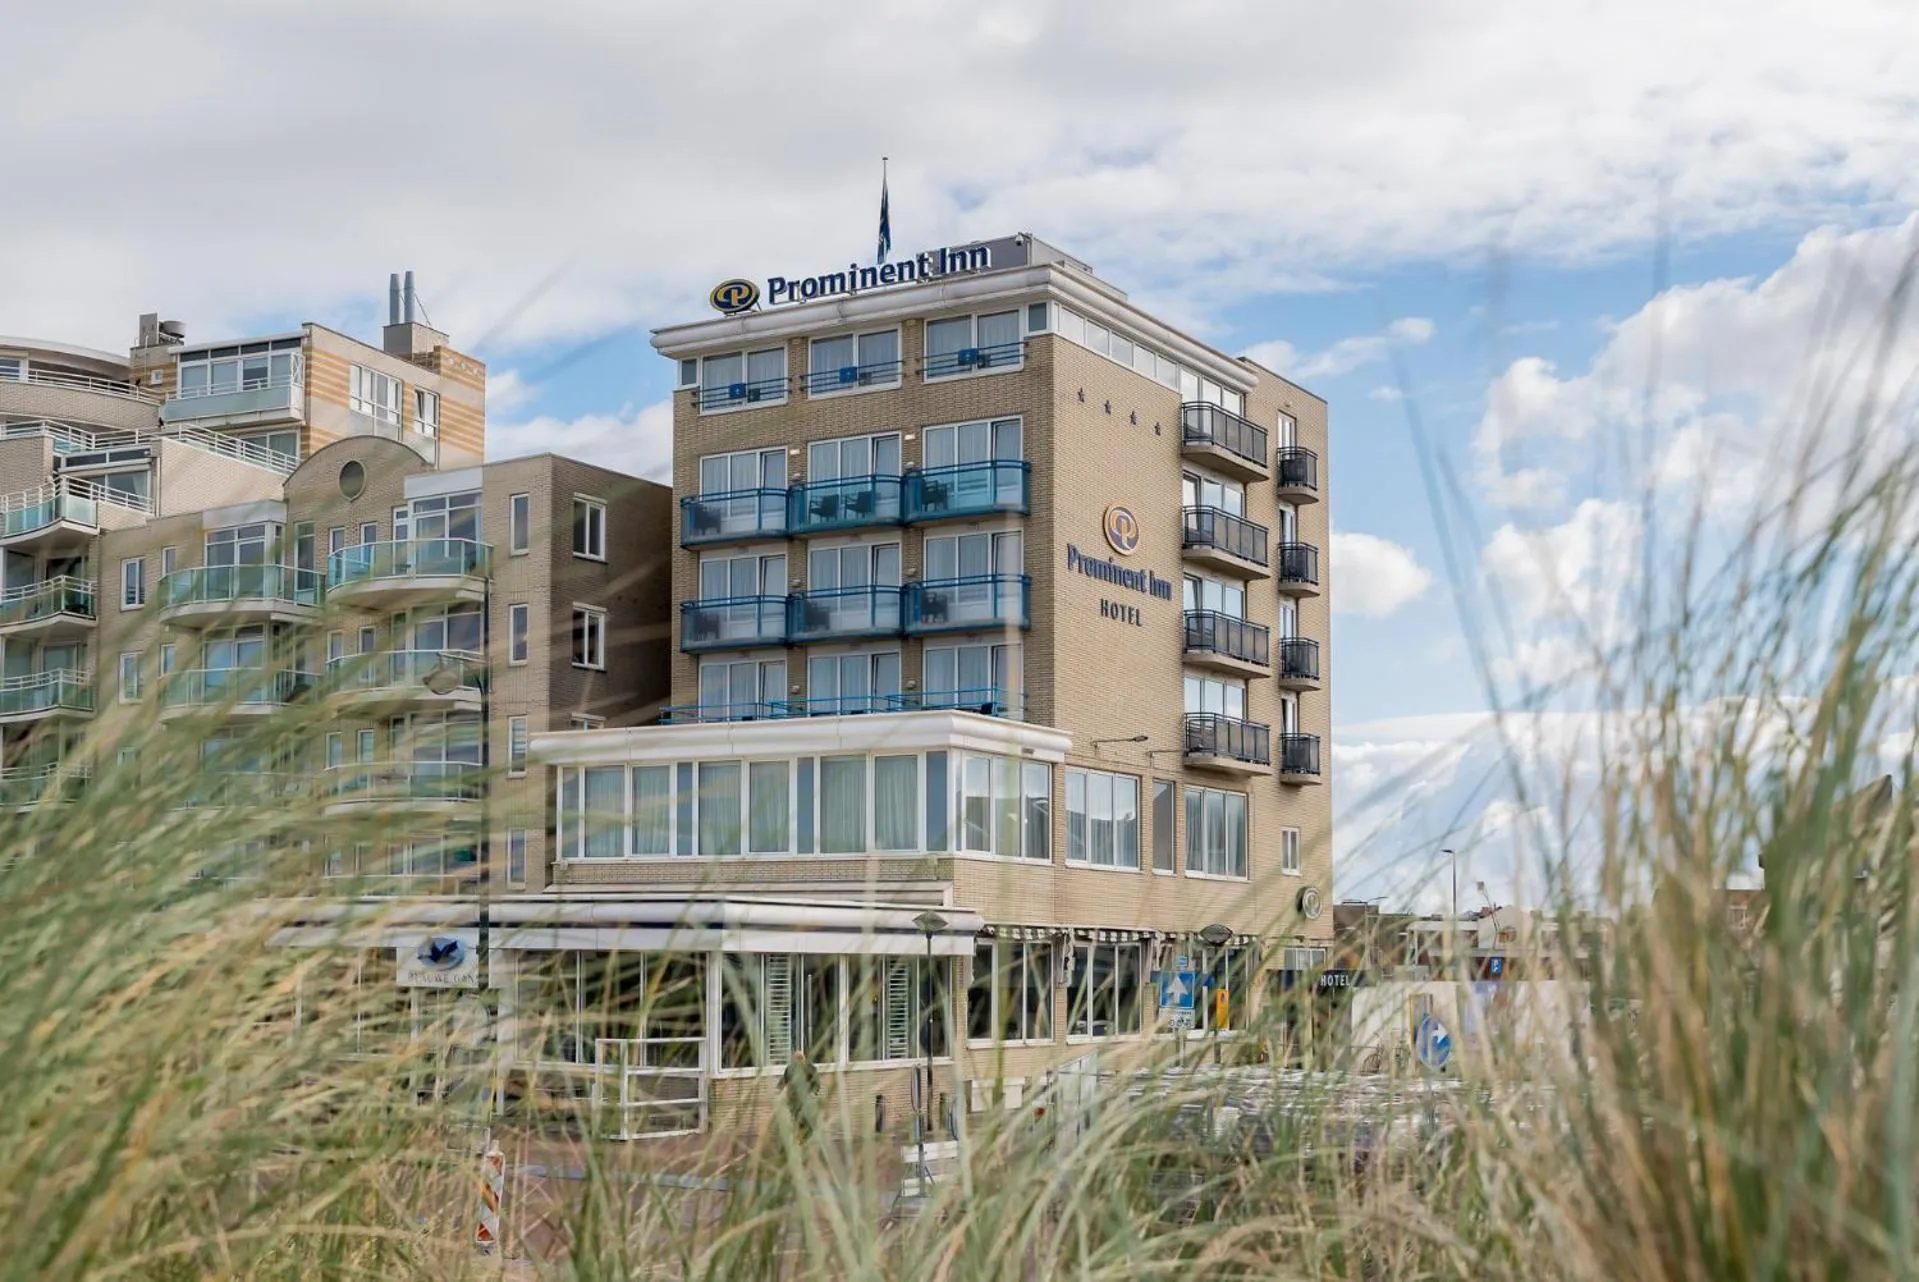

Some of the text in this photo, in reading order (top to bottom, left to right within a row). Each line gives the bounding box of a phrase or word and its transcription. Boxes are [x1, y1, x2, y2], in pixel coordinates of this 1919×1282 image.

[768, 245, 991, 303] Prominent Inn
[1067, 543, 1172, 601] Prominent Inn
[1100, 598, 1142, 627] HOTEL
[1320, 974, 1350, 987] HOTEL
